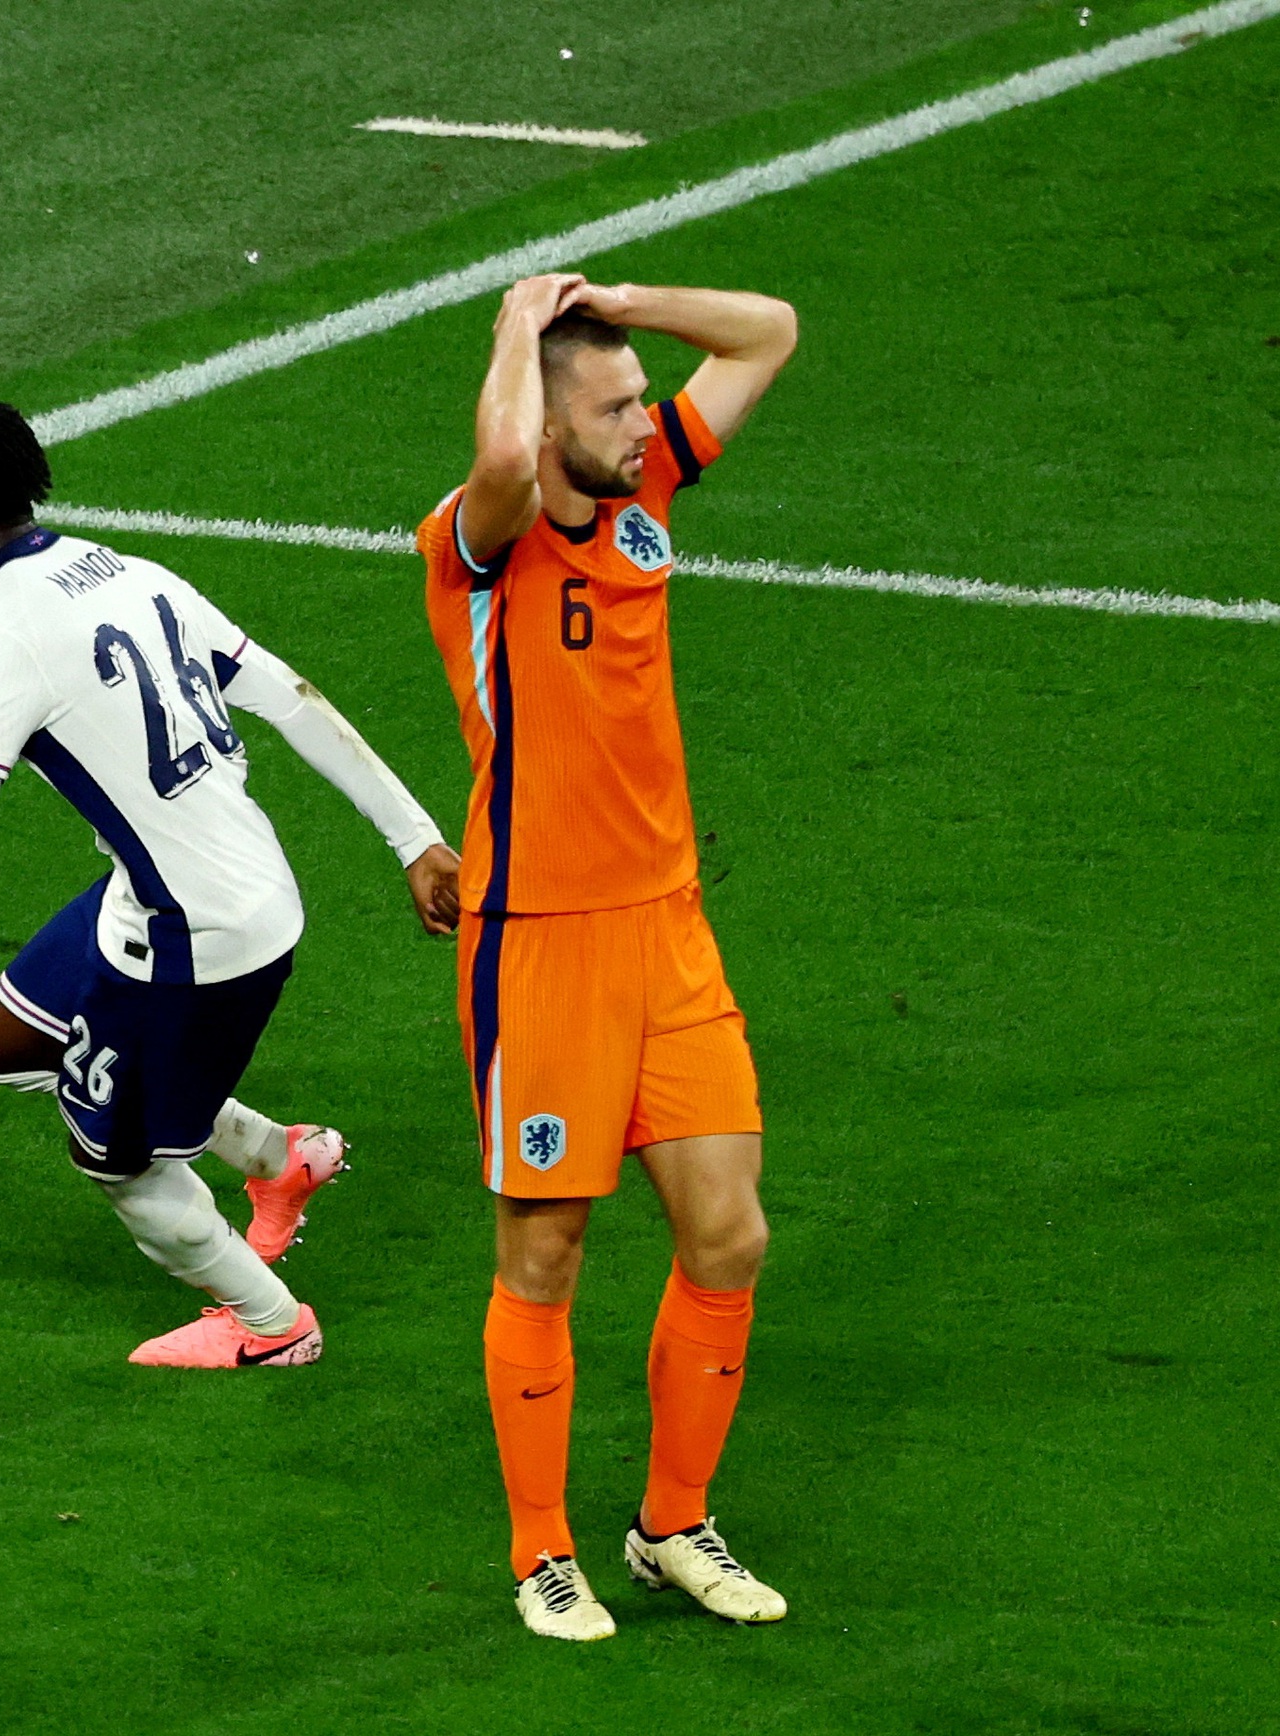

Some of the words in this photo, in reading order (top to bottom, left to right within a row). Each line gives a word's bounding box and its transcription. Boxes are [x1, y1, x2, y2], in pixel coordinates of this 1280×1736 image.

[45, 547, 126, 600] MAINOO
[561, 578, 593, 650] 6
[94, 593, 246, 800] 26
[63, 1014, 119, 1106] 26
